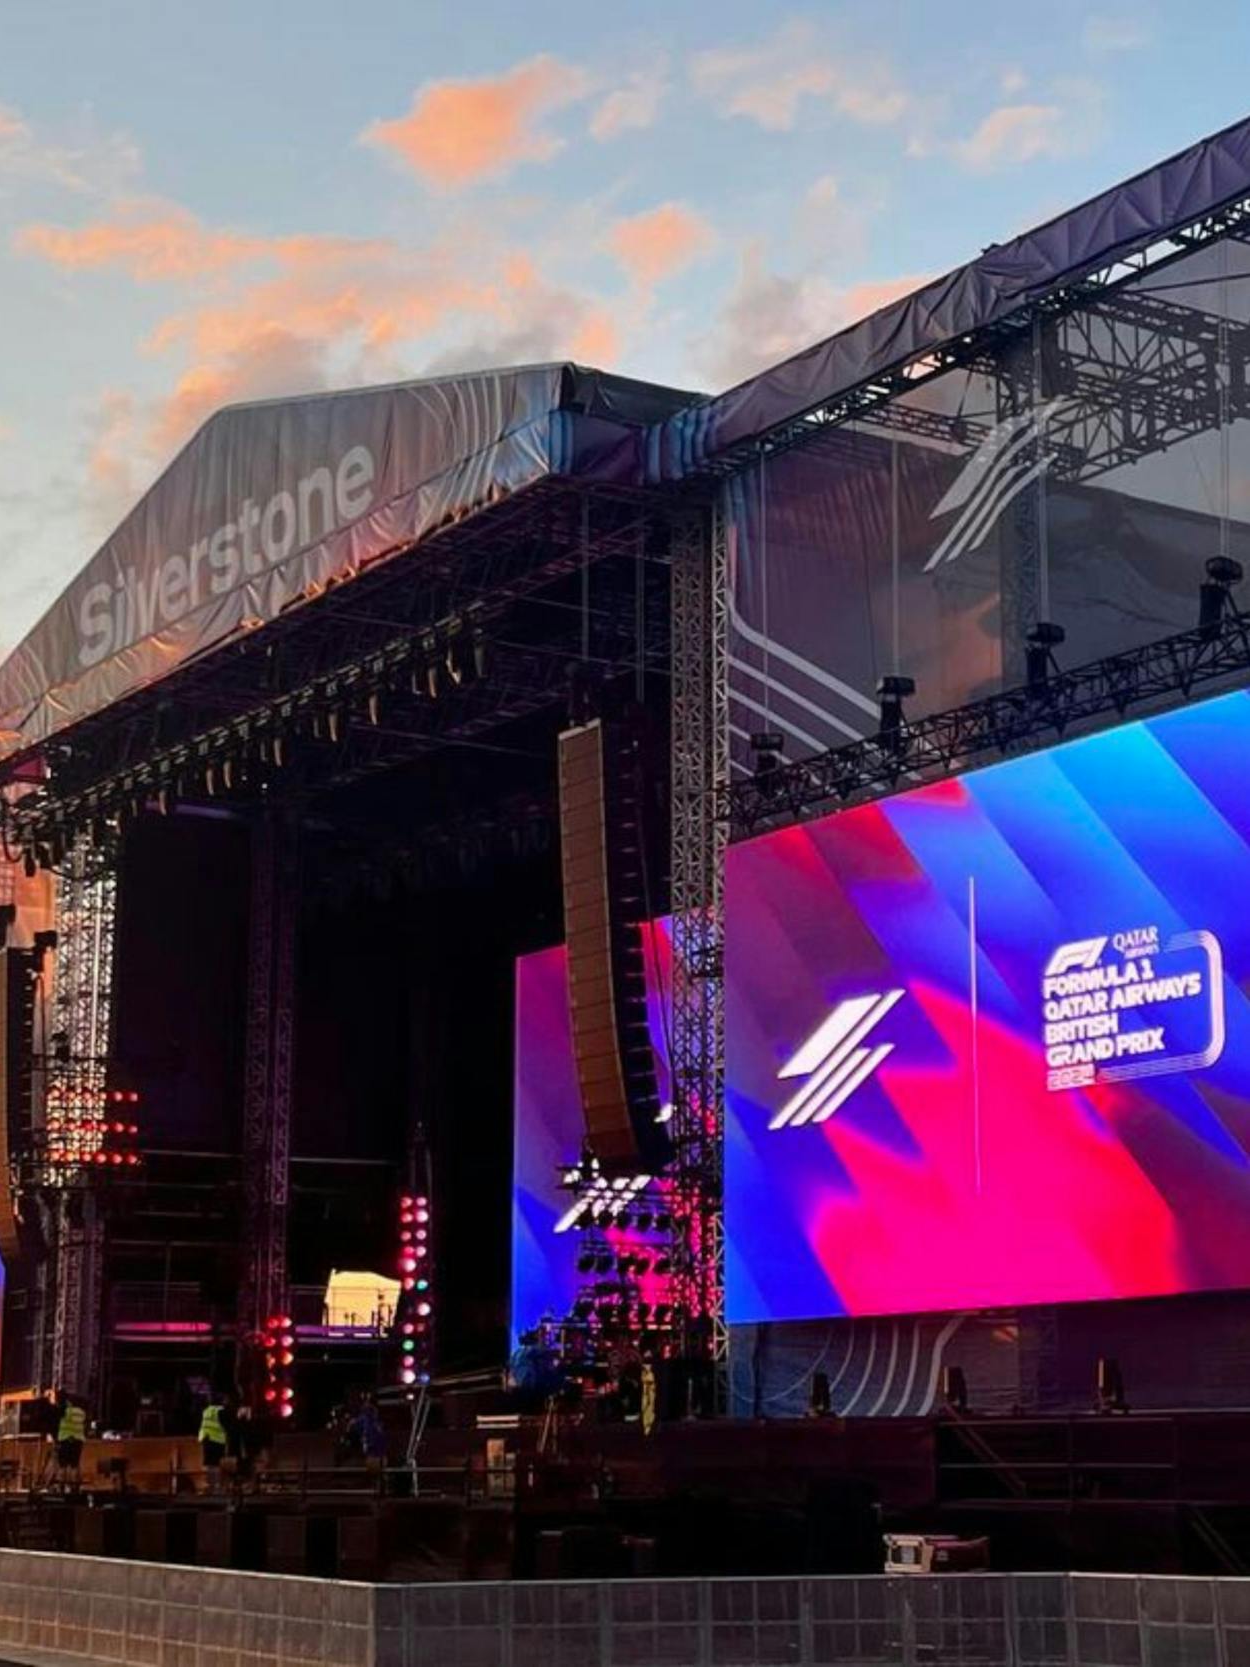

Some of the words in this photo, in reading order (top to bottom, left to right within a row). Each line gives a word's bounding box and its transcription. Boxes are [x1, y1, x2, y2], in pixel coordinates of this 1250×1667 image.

[79, 444, 376, 666] Silverstone
[1113, 926, 1159, 952] QATAR
[1044, 962, 1140, 999] FORMULA
[1141, 958, 1154, 980] 1
[1044, 994, 1112, 1021] QATAR
[1112, 972, 1202, 1010] AIRWAYS
[1045, 1013, 1119, 1045] BRITISH
[1046, 1039, 1115, 1068] GRAND
[1116, 1028, 1165, 1057] PRIX
